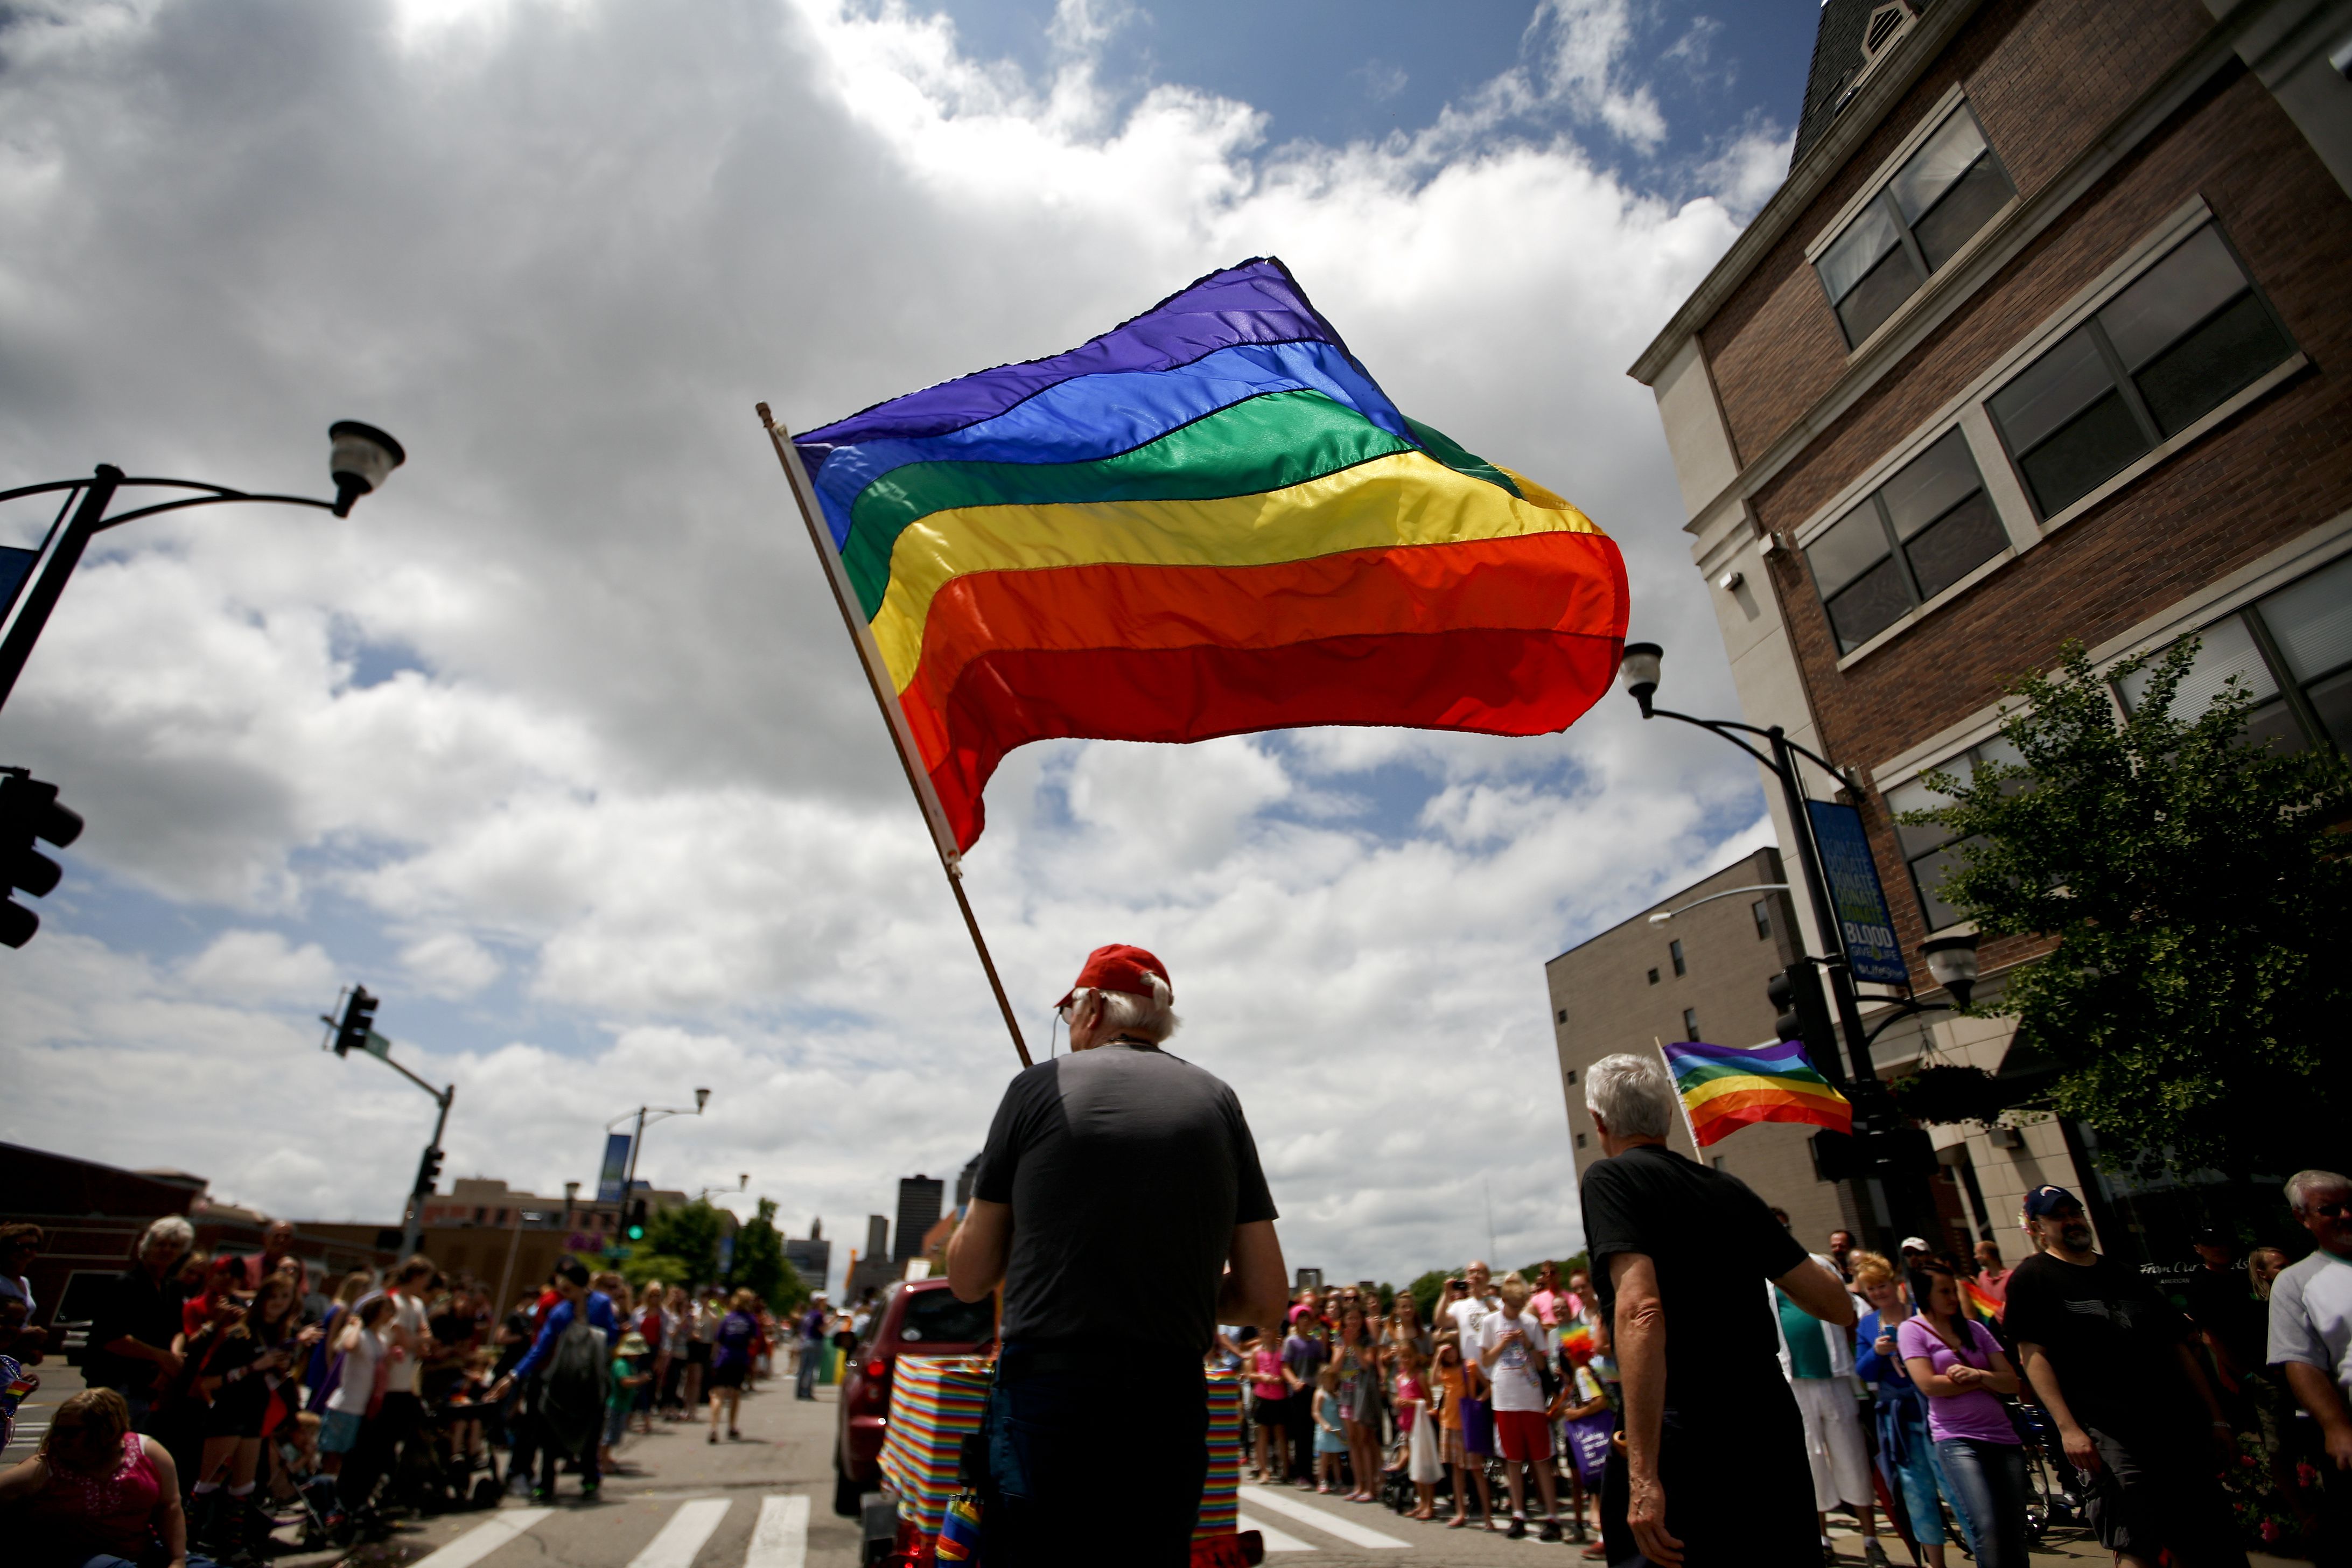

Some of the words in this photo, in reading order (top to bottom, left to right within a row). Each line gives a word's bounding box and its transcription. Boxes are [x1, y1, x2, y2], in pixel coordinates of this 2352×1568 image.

[1826, 854, 1871, 872] DONATE
[1831, 870, 1875, 890] DONATE
[1836, 887, 1881, 908] DONATE
[1840, 905, 1887, 926] DONATE
[1844, 921, 1894, 948] BLOOD
[1851, 946, 1873, 957] GIVE
[1880, 948, 1899, 961] LIFE
[2140, 1263, 2172, 1274] From
[2174, 1261, 2200, 1273] Our
